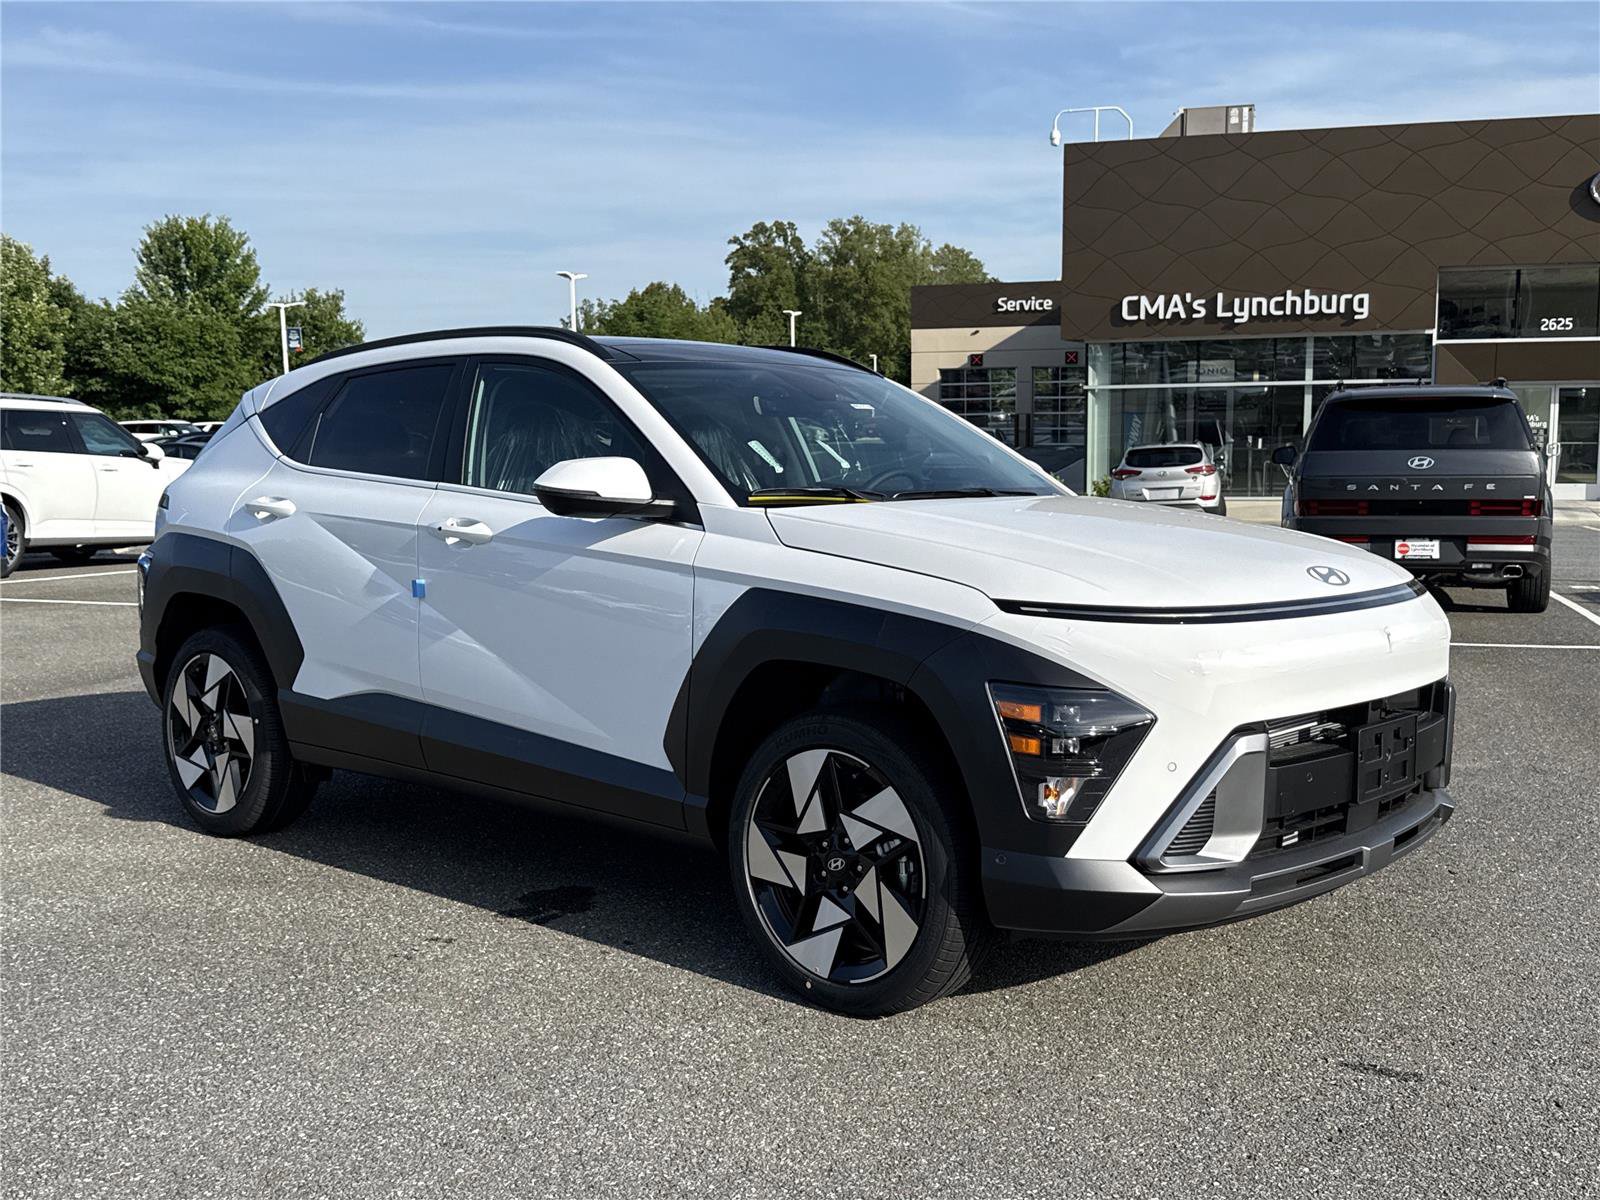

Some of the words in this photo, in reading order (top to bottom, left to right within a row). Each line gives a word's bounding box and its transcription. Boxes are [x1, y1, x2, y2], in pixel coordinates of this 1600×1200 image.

[997, 296, 1053, 311] Service
[1121, 293, 1206, 321] CMA's
[1216, 289, 1370, 324] Lynchburg
[1540, 317, 1573, 331] 2625
[1346, 483, 1444, 491] SANTA
